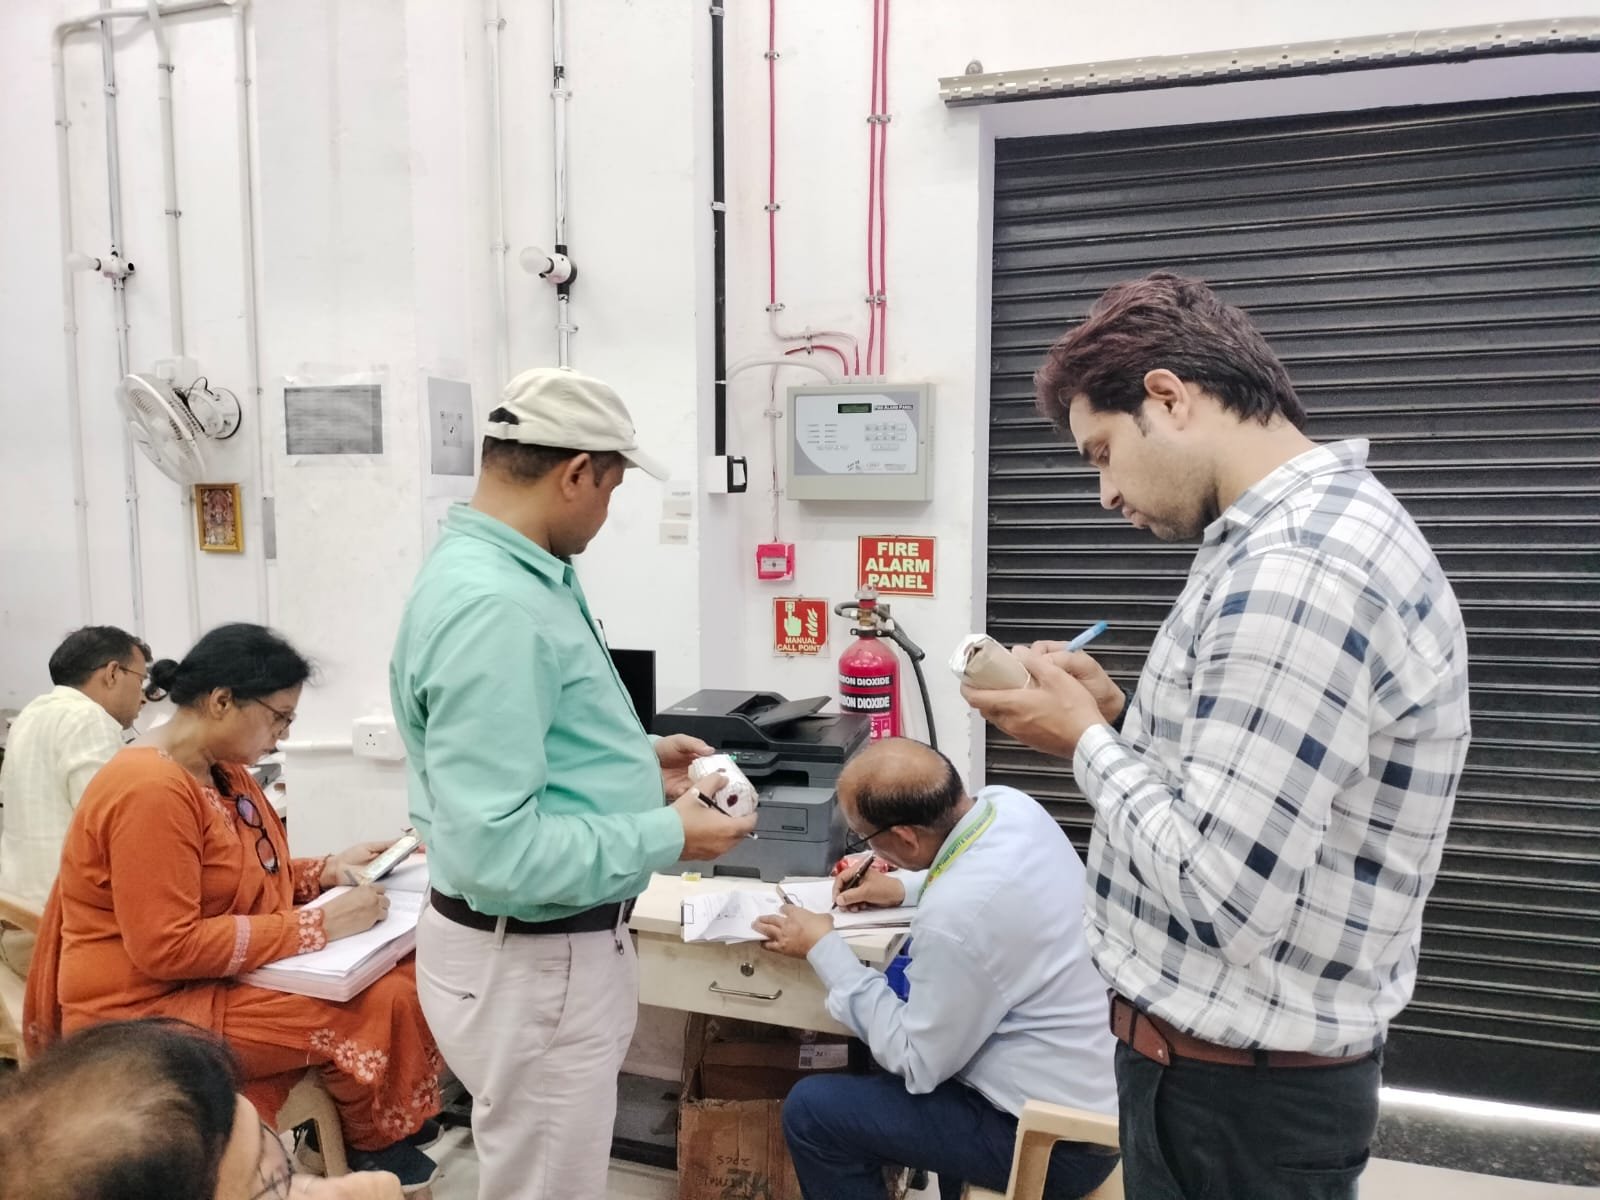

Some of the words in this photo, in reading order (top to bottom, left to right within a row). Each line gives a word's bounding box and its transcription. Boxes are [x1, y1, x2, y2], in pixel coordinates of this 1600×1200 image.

[877, 541, 920, 557] FIRE
[865, 557, 930, 573] ALARM
[868, 573, 928, 589] PANEL
[785, 636, 817, 644] MANUAL
[777, 643, 797, 651] CALL
[857, 676, 890, 687] DIOXIDE
[857, 696, 890, 709] DIOXIDE
